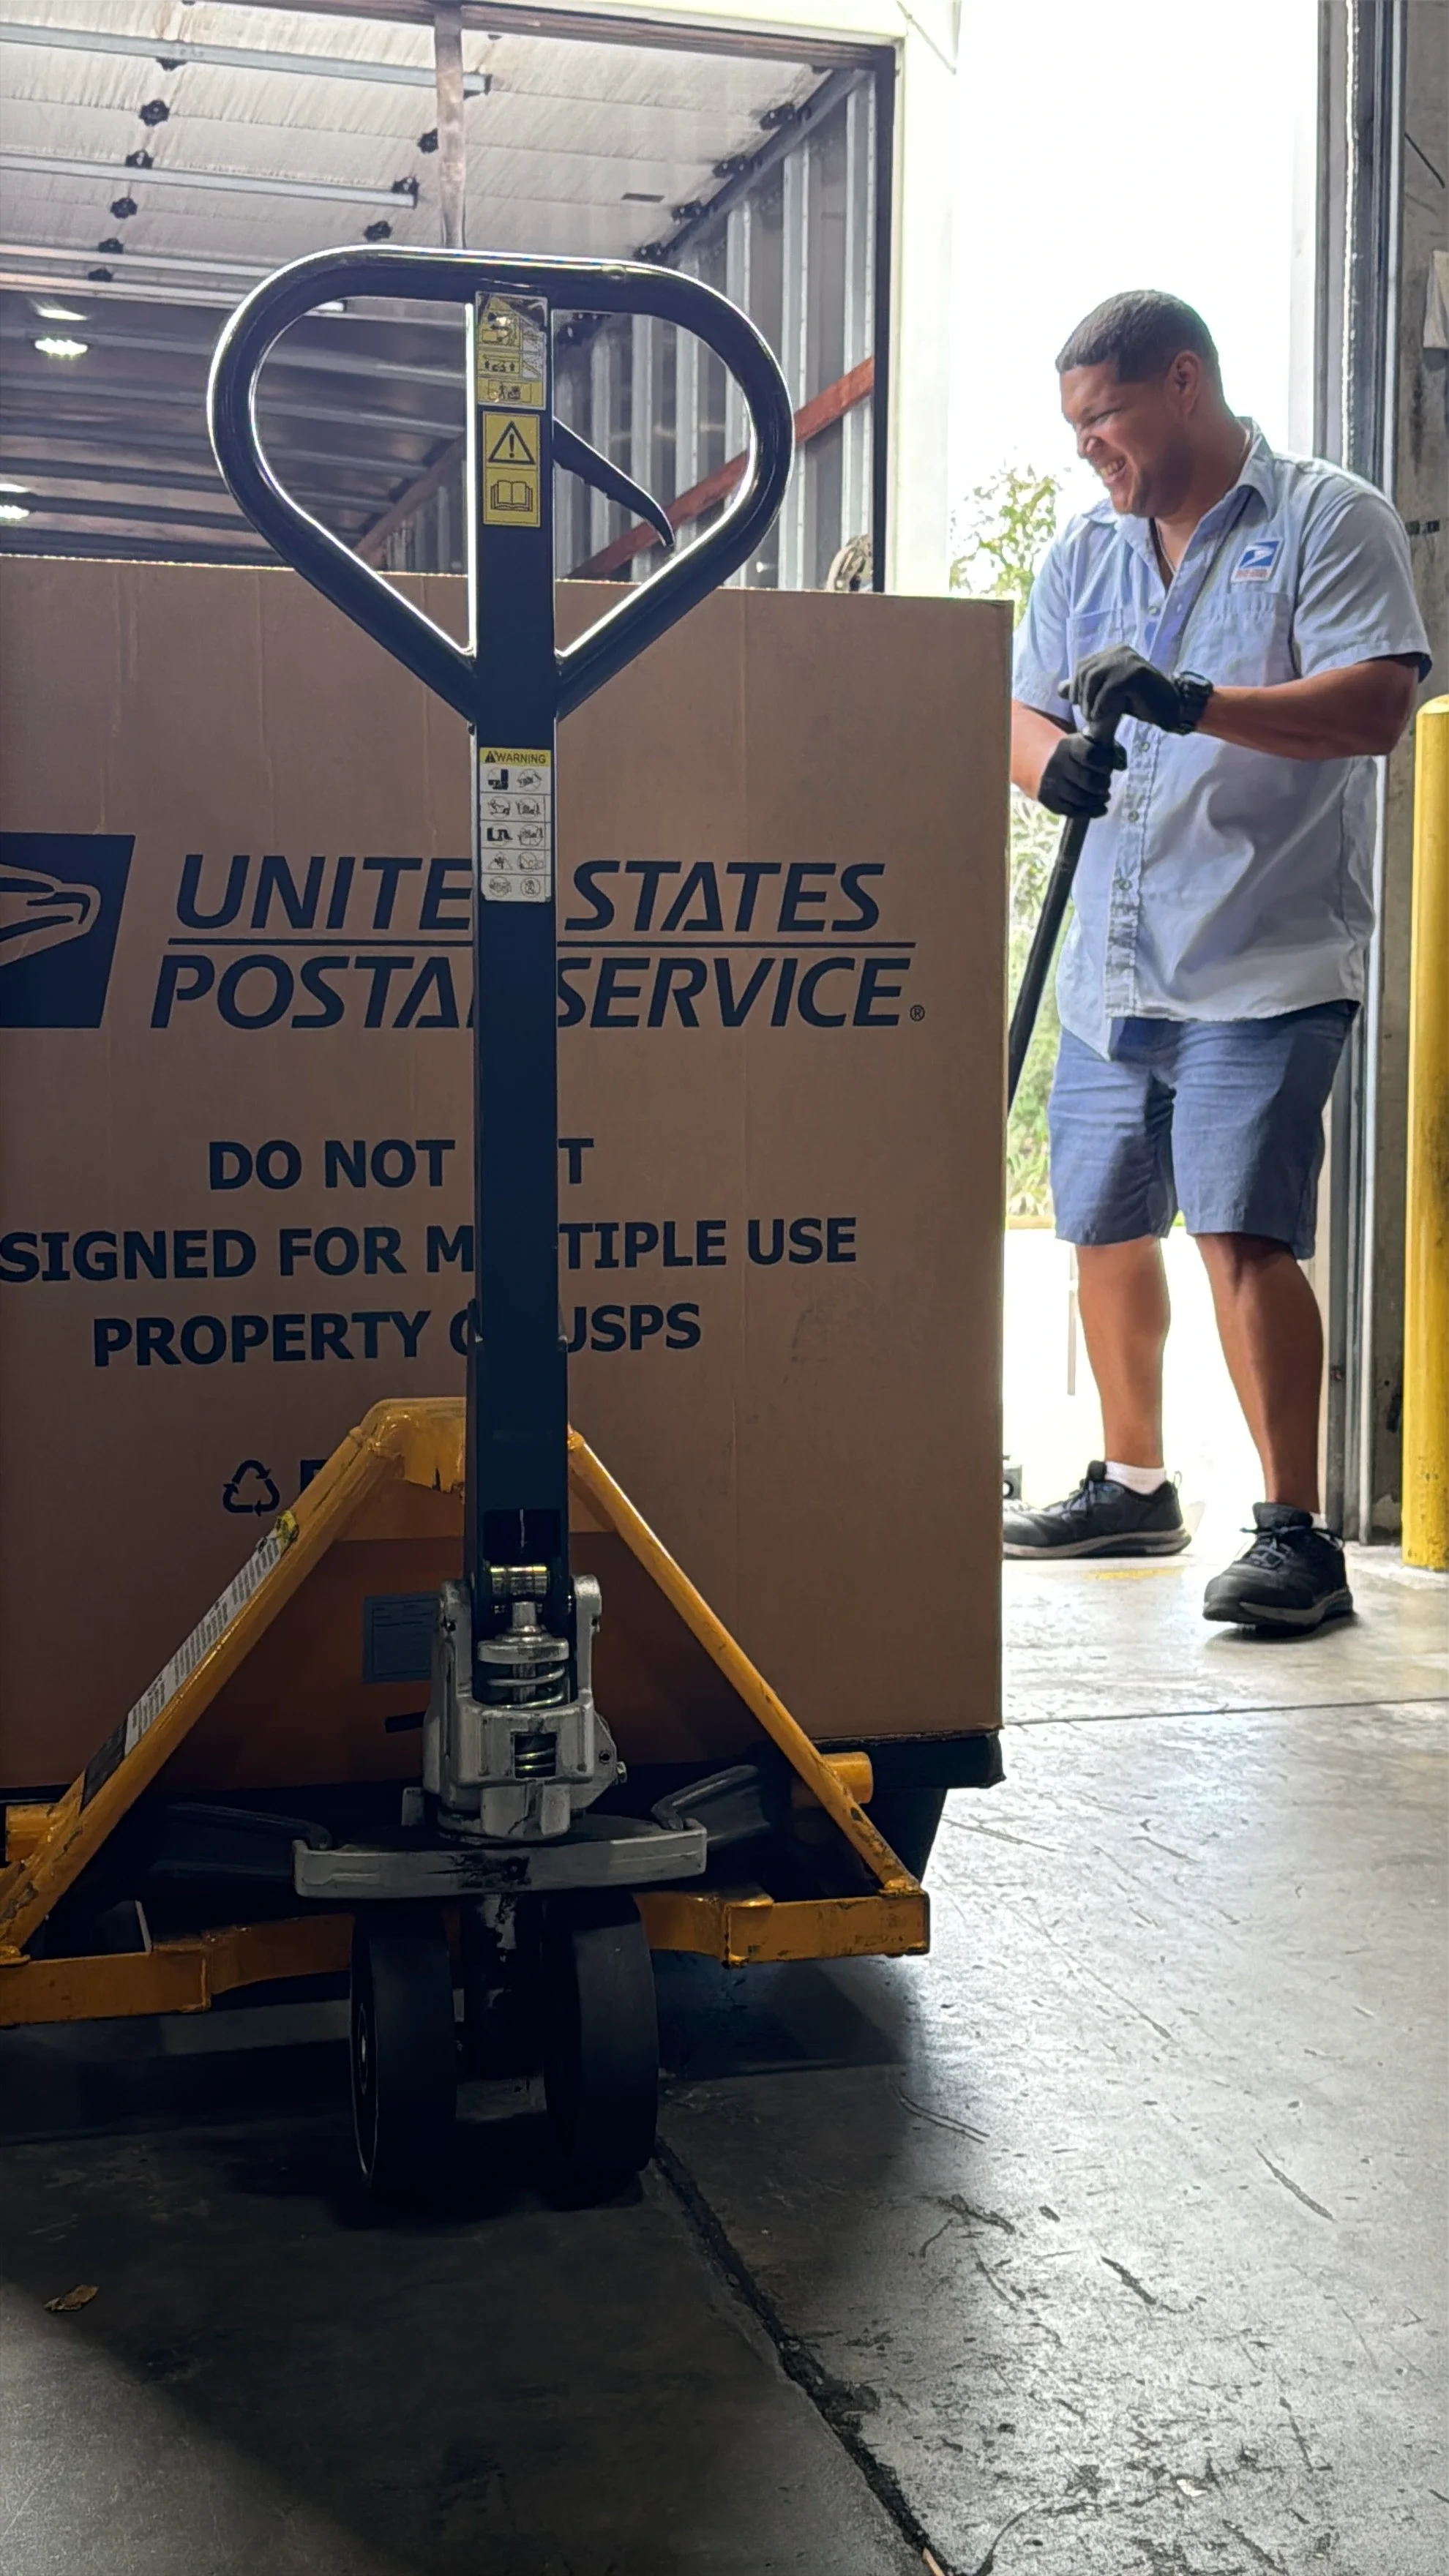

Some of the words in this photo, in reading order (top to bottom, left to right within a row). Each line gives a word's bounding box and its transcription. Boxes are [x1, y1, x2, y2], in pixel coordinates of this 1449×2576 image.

[497, 752, 547, 764] WARNING
[177, 855, 472, 930] UNITE
[564, 861, 885, 932] STATES
[151, 954, 472, 1029] POSTA
[209, 1140, 302, 1190] DO
[325, 1139, 455, 1188] NOT
[0, 1229, 256, 1282] SIGNED
[280, 1227, 406, 1276] FOR
[427, 1221, 727, 1273] MTIPLE
[748, 1218, 856, 1265] USE
[94, 1311, 430, 1366] PROPERTY
